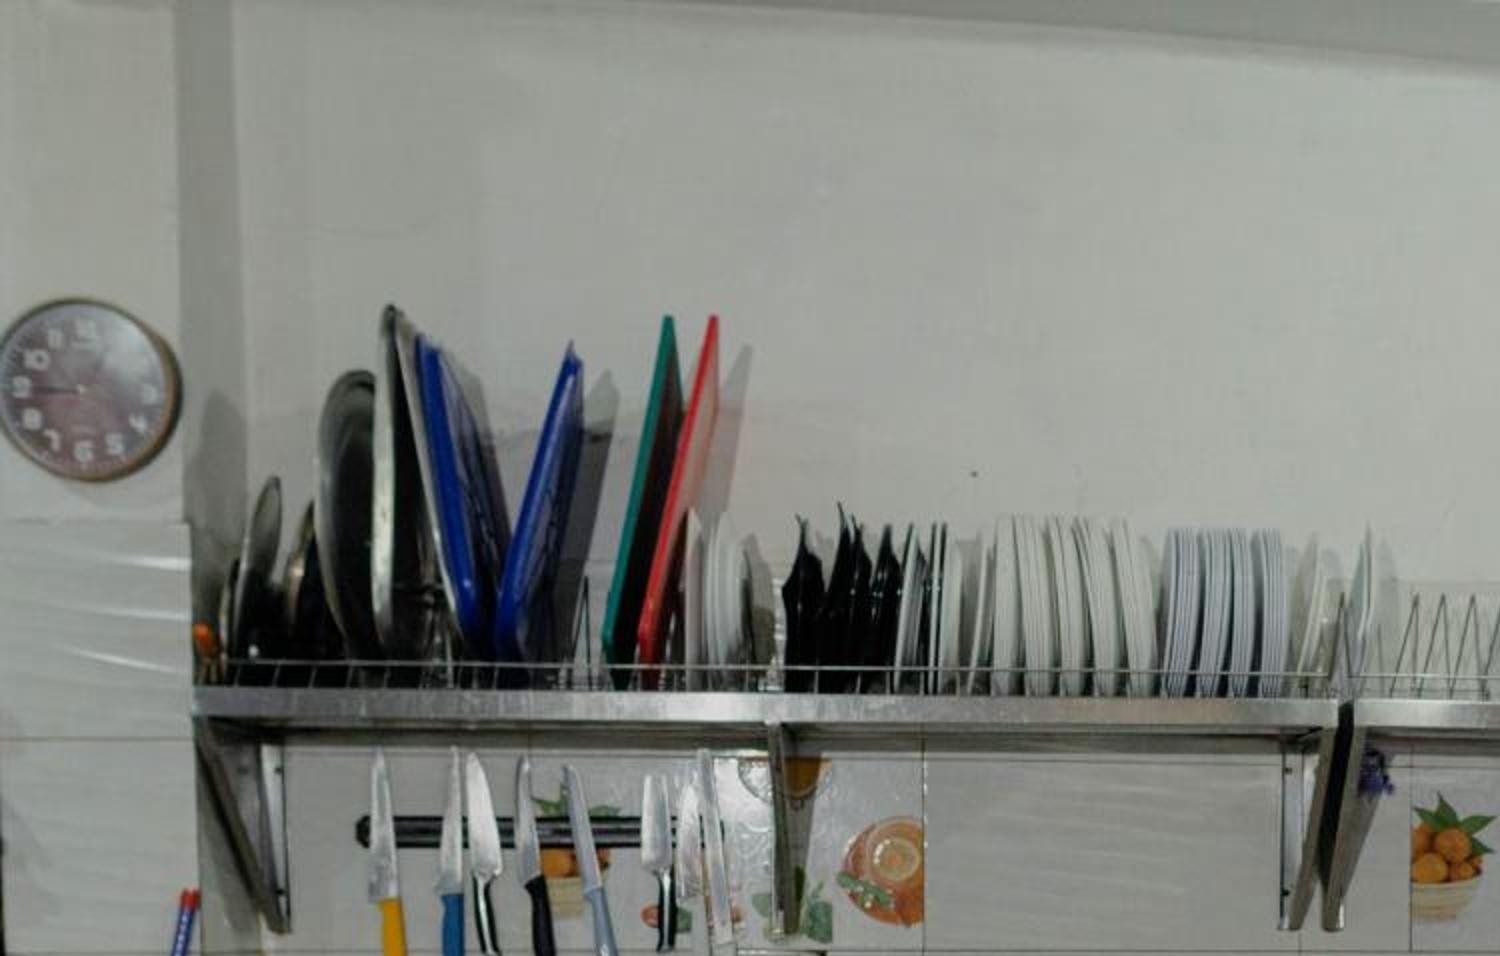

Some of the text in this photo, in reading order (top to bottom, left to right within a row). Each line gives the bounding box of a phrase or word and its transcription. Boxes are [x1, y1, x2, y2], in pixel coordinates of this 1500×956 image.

[24, 349, 50, 370] 10
[43, 428, 61, 453] 7
[73, 439, 94, 463] 6
[105, 432, 125, 455] 5
